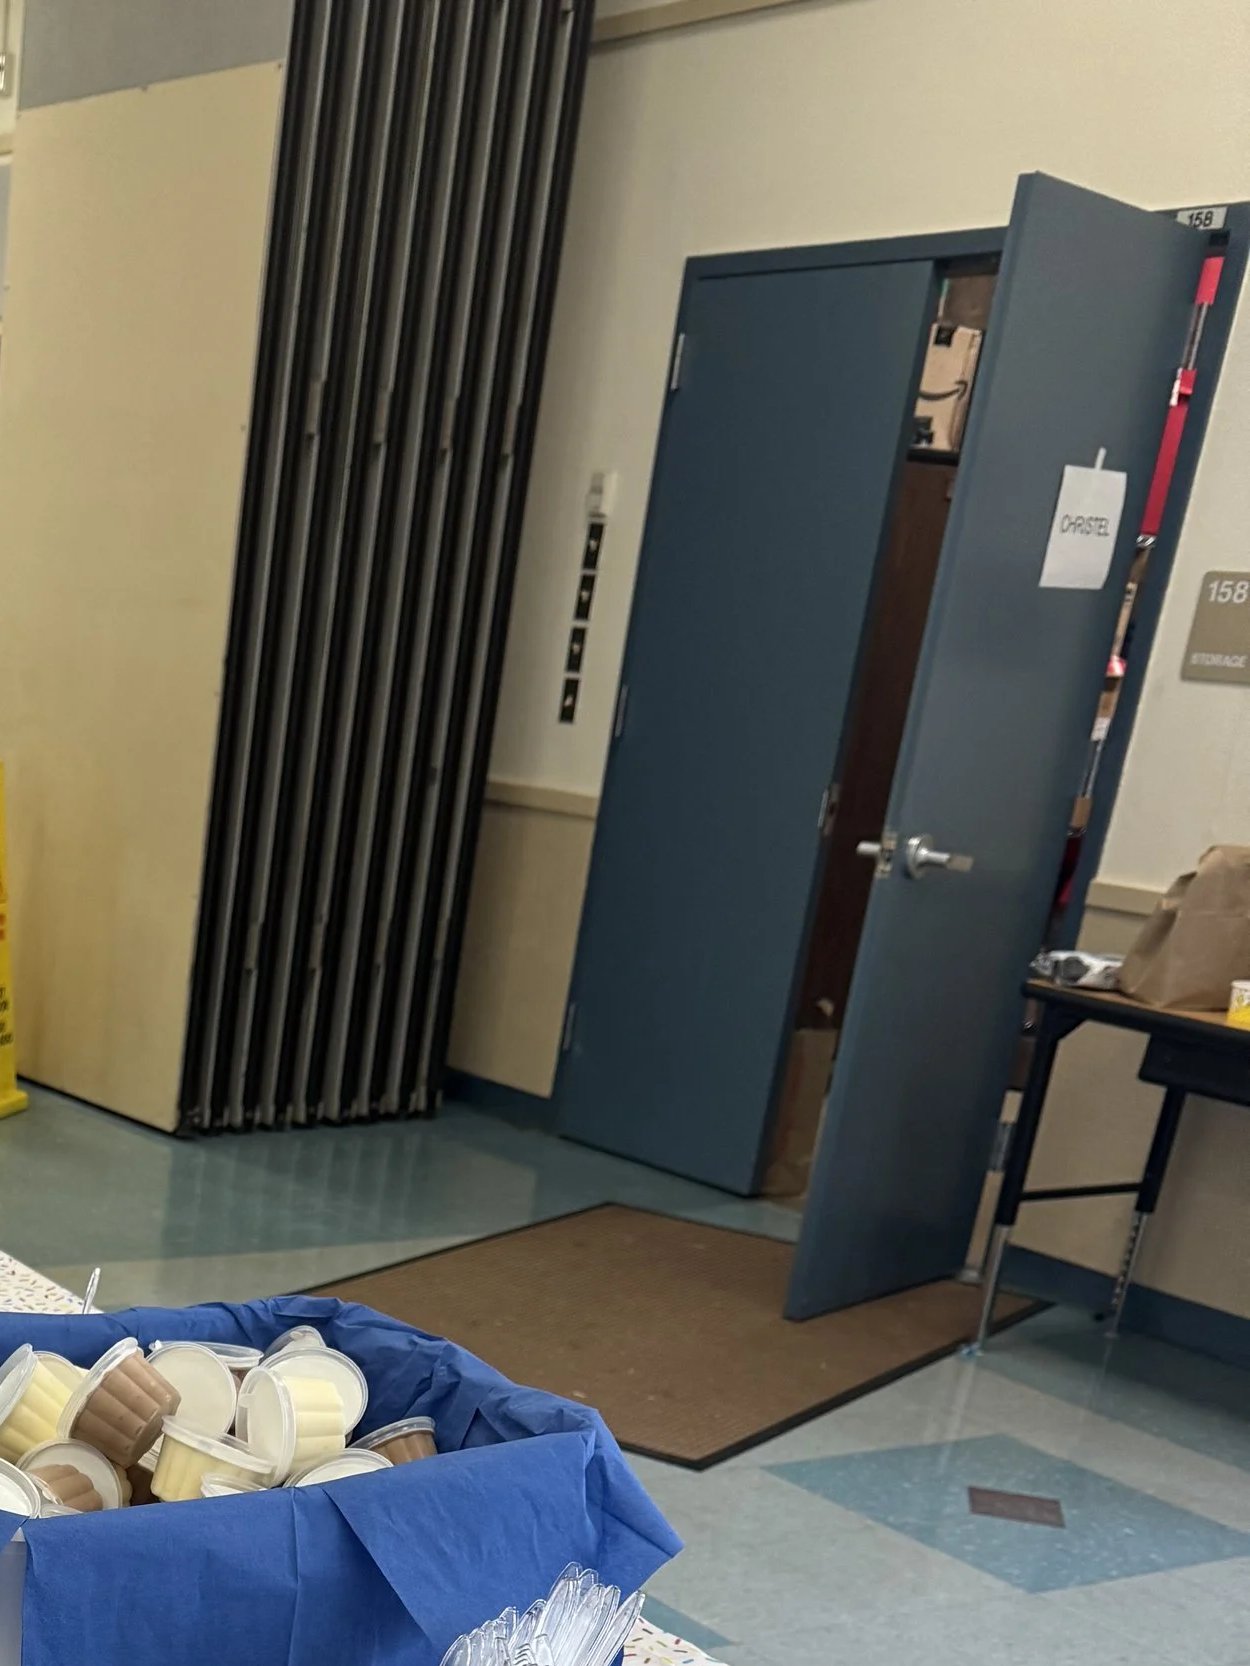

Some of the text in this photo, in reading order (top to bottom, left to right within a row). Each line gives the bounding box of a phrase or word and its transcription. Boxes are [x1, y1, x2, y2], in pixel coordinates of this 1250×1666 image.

[1188, 210, 1214, 229] 158
[1060, 514, 1110, 537] CHRISTEL
[1208, 580, 1249, 604] 158
[1191, 651, 1247, 669] STORAGE
